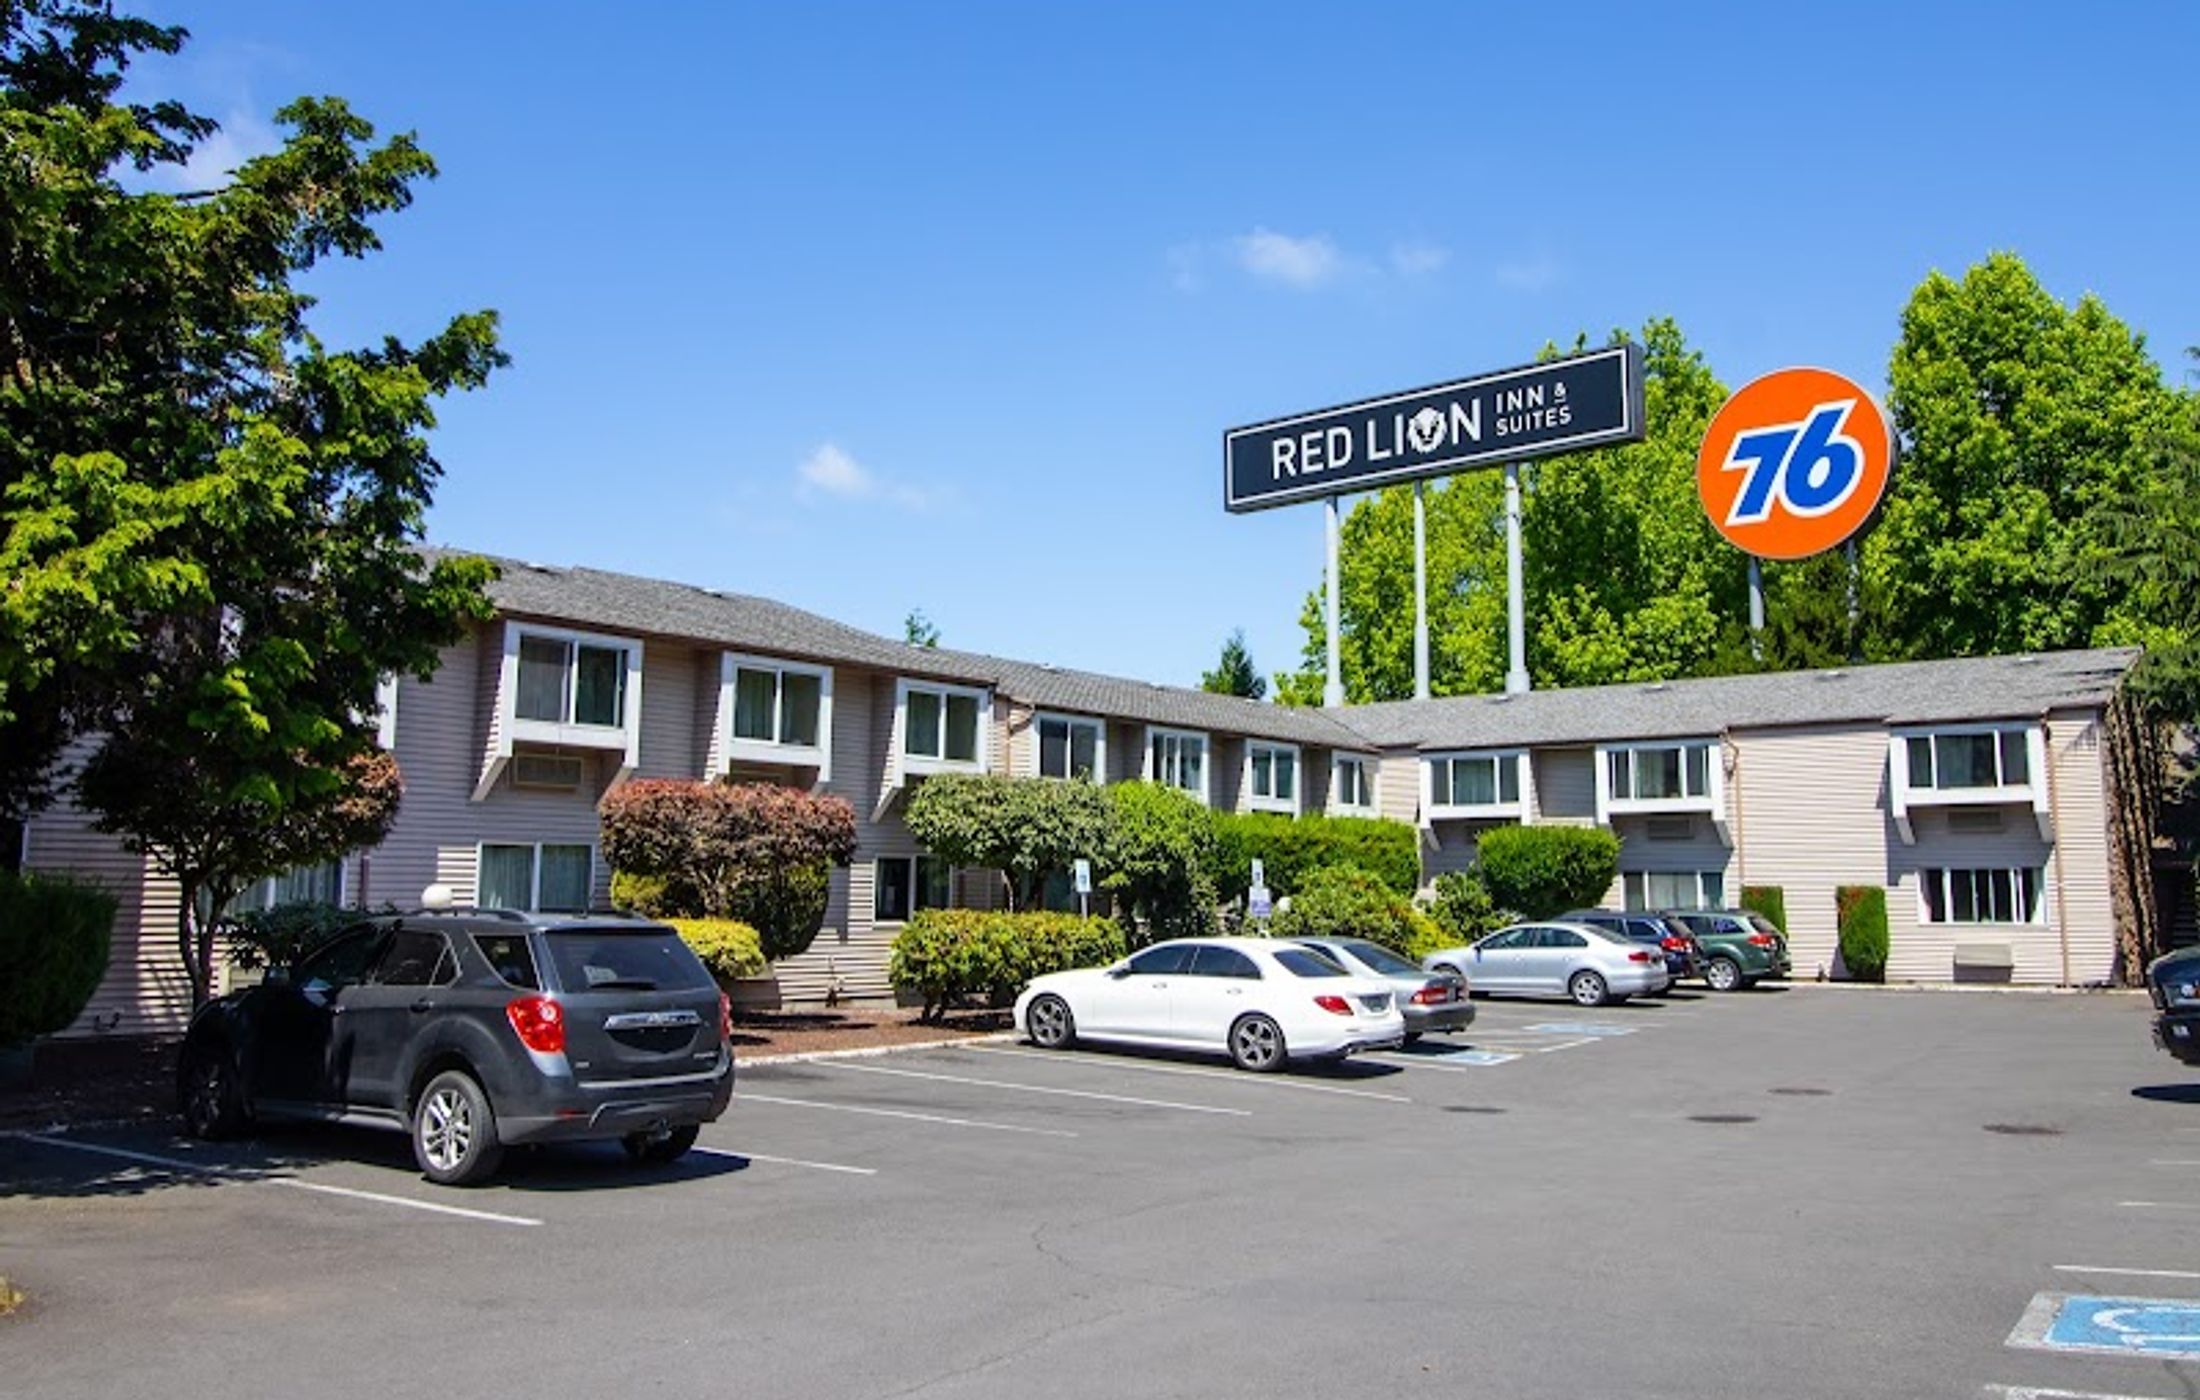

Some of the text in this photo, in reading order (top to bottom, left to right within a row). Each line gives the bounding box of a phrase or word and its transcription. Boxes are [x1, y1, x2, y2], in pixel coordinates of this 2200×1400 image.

[1496, 382, 1567, 414] INN &
[1496, 404, 1572, 436] SUITES
[1272, 426, 1352, 480] RED
[1721, 399, 1865, 526] 76
